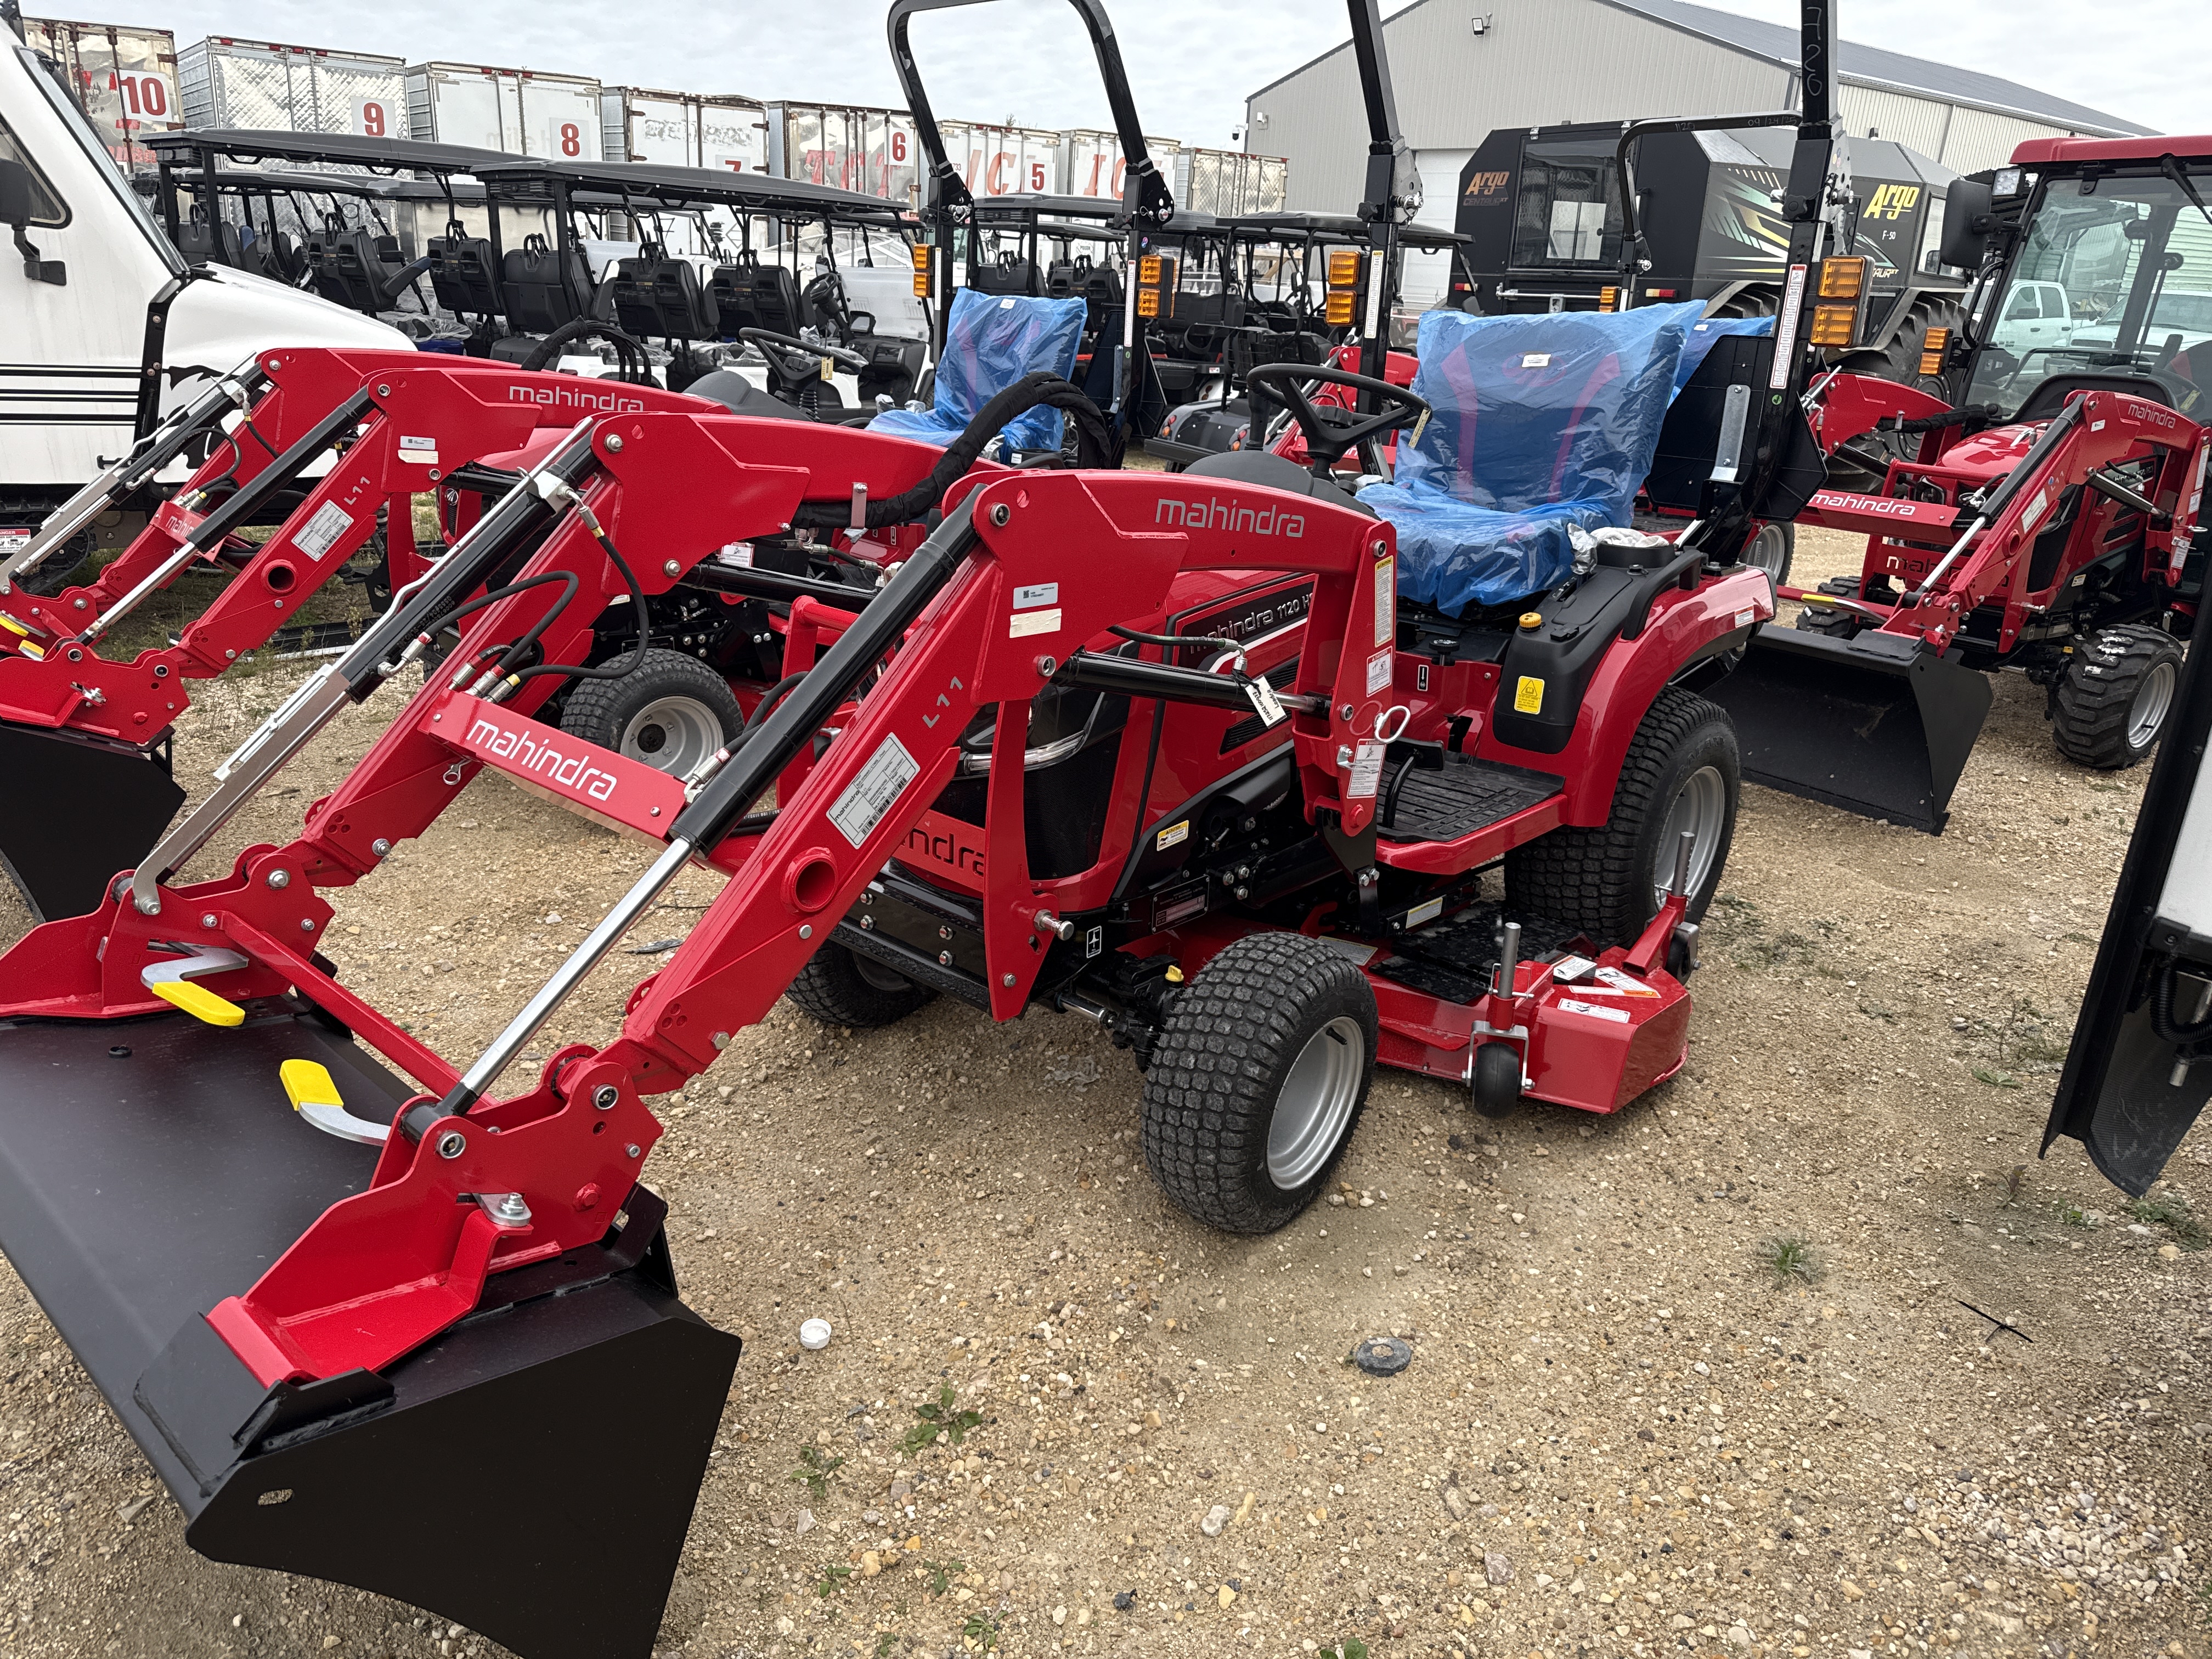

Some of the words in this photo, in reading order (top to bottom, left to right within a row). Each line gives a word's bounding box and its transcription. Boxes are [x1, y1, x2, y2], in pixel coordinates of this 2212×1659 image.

[120, 76, 166, 116] 10
[364, 102, 386, 137] 9
[1675, 122, 1695, 132] 1120
[561, 123, 580, 157] 8
[892, 132, 906, 162] 6
[725, 160, 741, 172] 7
[1032, 163, 1045, 191] 5
[1464, 171, 1510, 195] Argo
[1863, 184, 1920, 220] Argo
[509, 386, 644, 413] mahindra
[2128, 403, 2176, 430] mahindra
[343, 476, 371, 506] L11
[1809, 494, 1916, 516] mahindra
[166, 516, 194, 538] mahin
[1155, 496, 1305, 538] mahindra
[1277, 599, 1300, 619] 1120
[923, 675, 964, 729] L11
[466, 719, 617, 802] mahindra
[833, 789, 861, 821] mahindra
[909, 827, 985, 877] ndra
